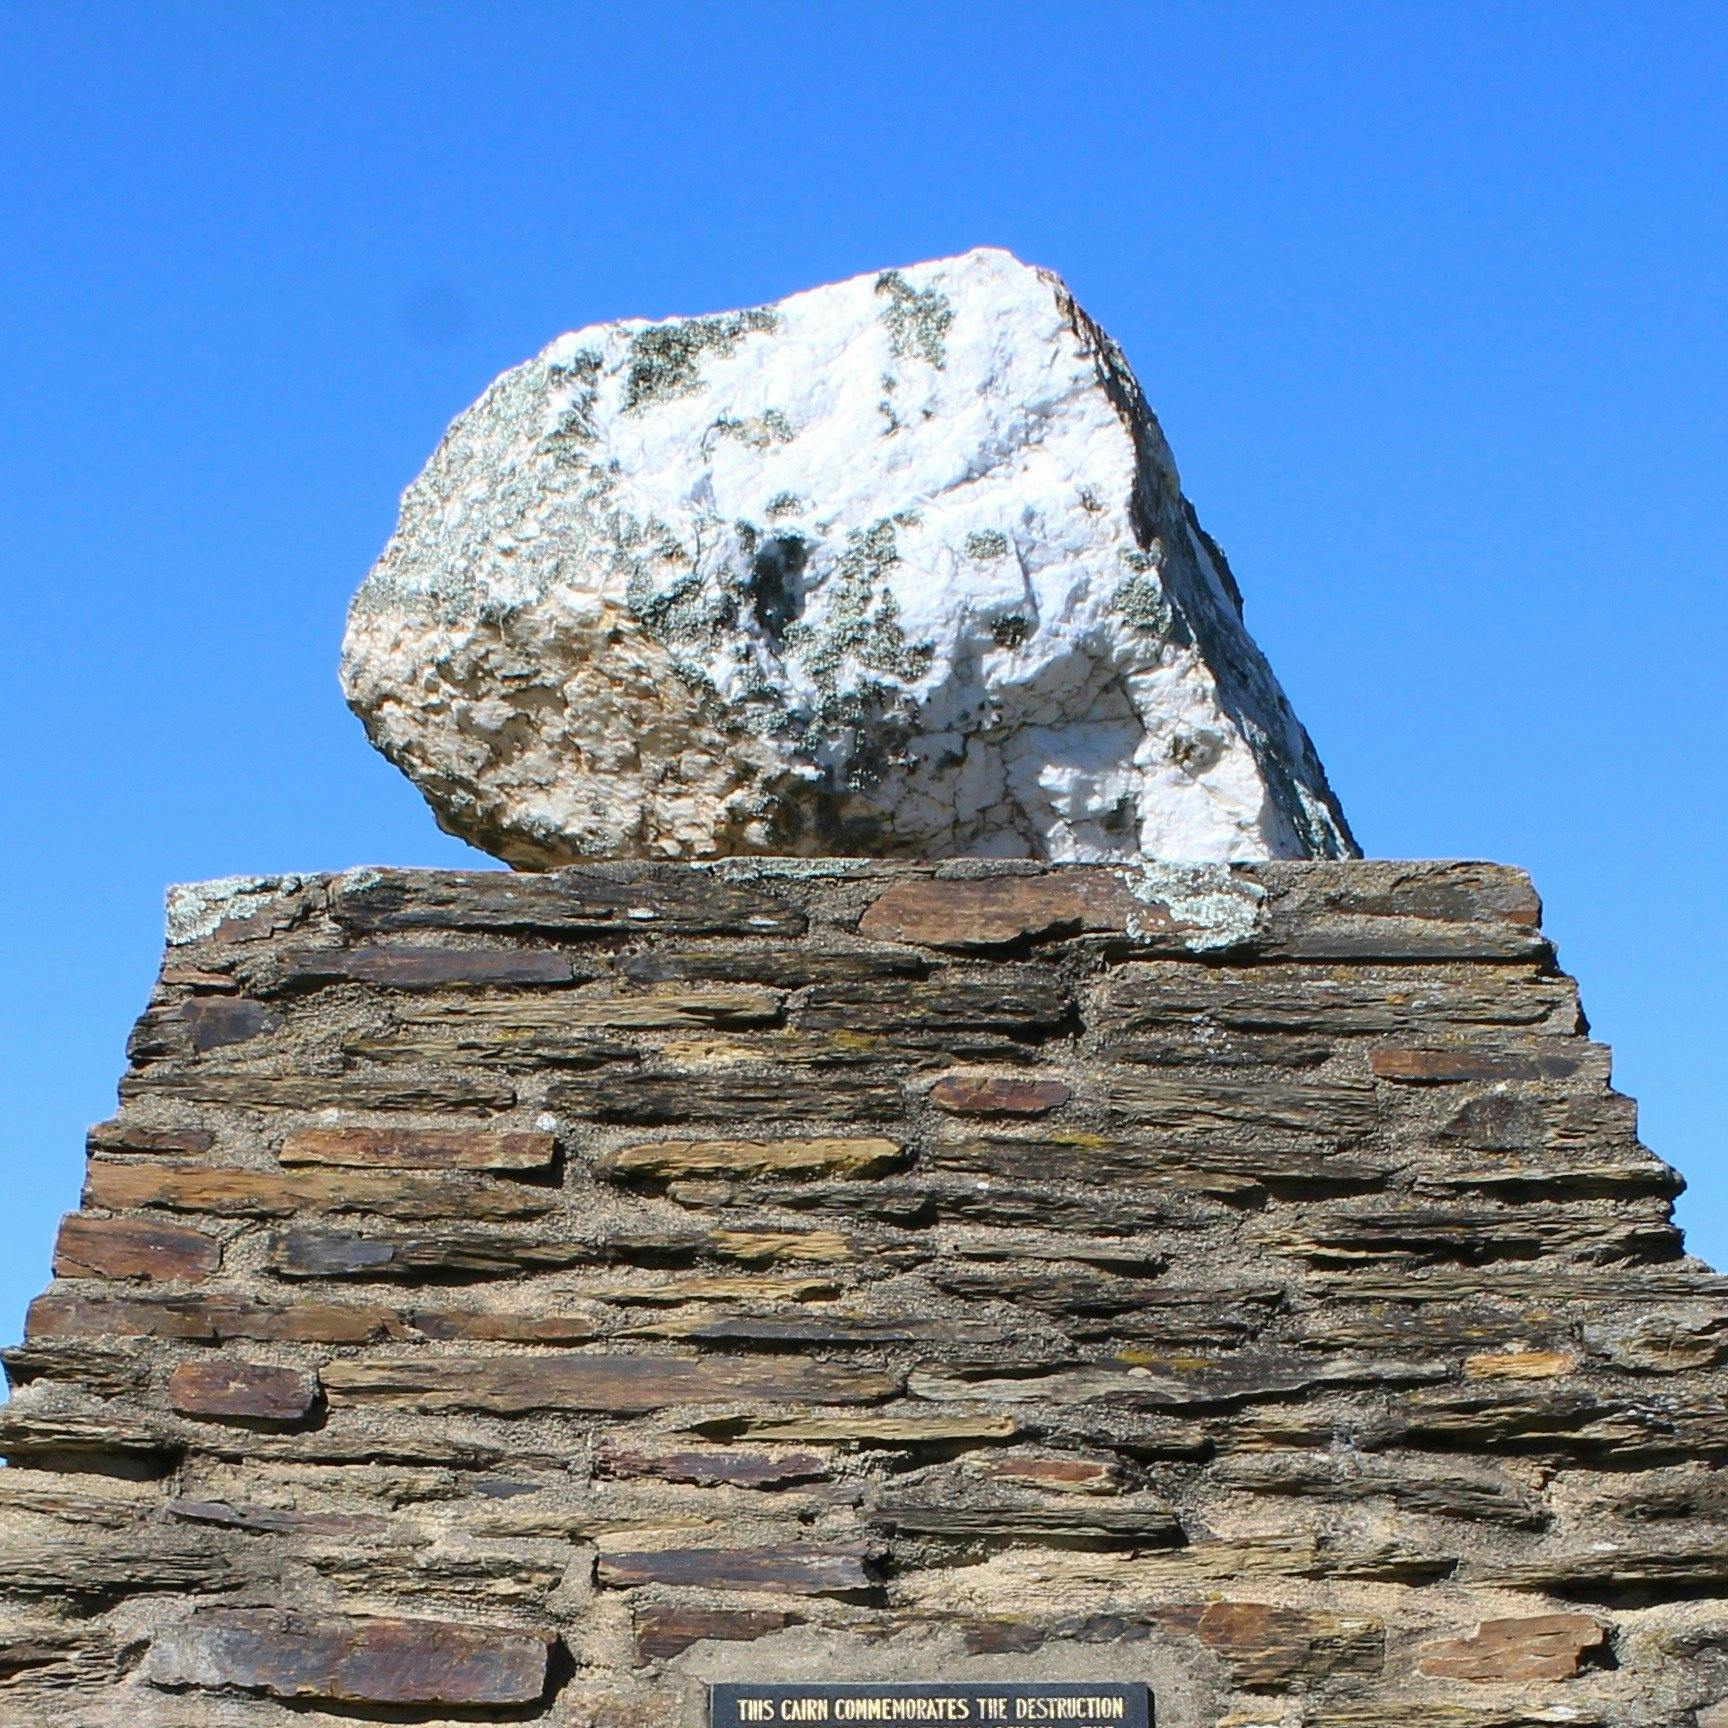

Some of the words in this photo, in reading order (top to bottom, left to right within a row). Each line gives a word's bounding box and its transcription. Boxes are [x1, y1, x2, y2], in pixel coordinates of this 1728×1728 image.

[737, 1699, 774, 1721] THIS
[781, 1699, 828, 1721] CAIRN
[834, 1698, 969, 1720] COMMEMORATES
[977, 1698, 1007, 1719] THE
[1016, 1697, 1124, 1719] DESTRUCTION
